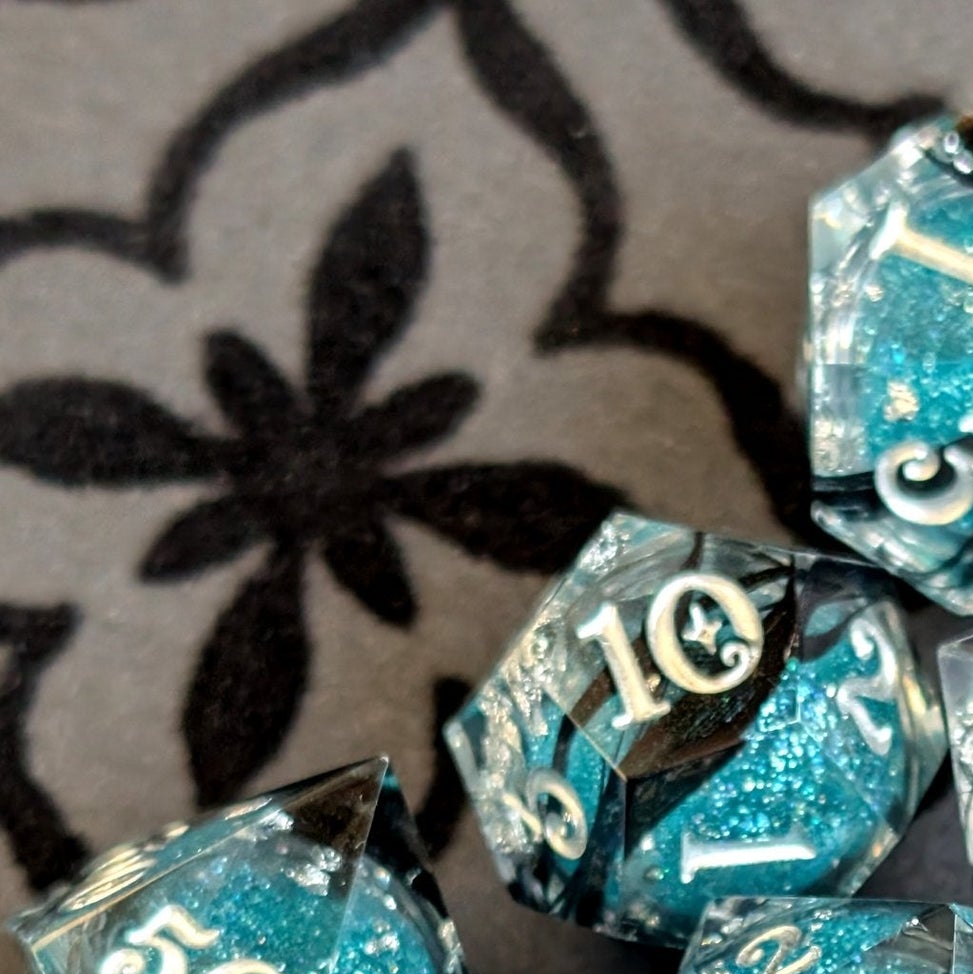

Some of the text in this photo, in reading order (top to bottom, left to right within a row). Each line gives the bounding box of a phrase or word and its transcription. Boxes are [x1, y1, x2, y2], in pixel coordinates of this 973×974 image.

[577, 571, 764, 730] 10
[835, 616, 898, 755] 2
[680, 821, 816, 884] 1
